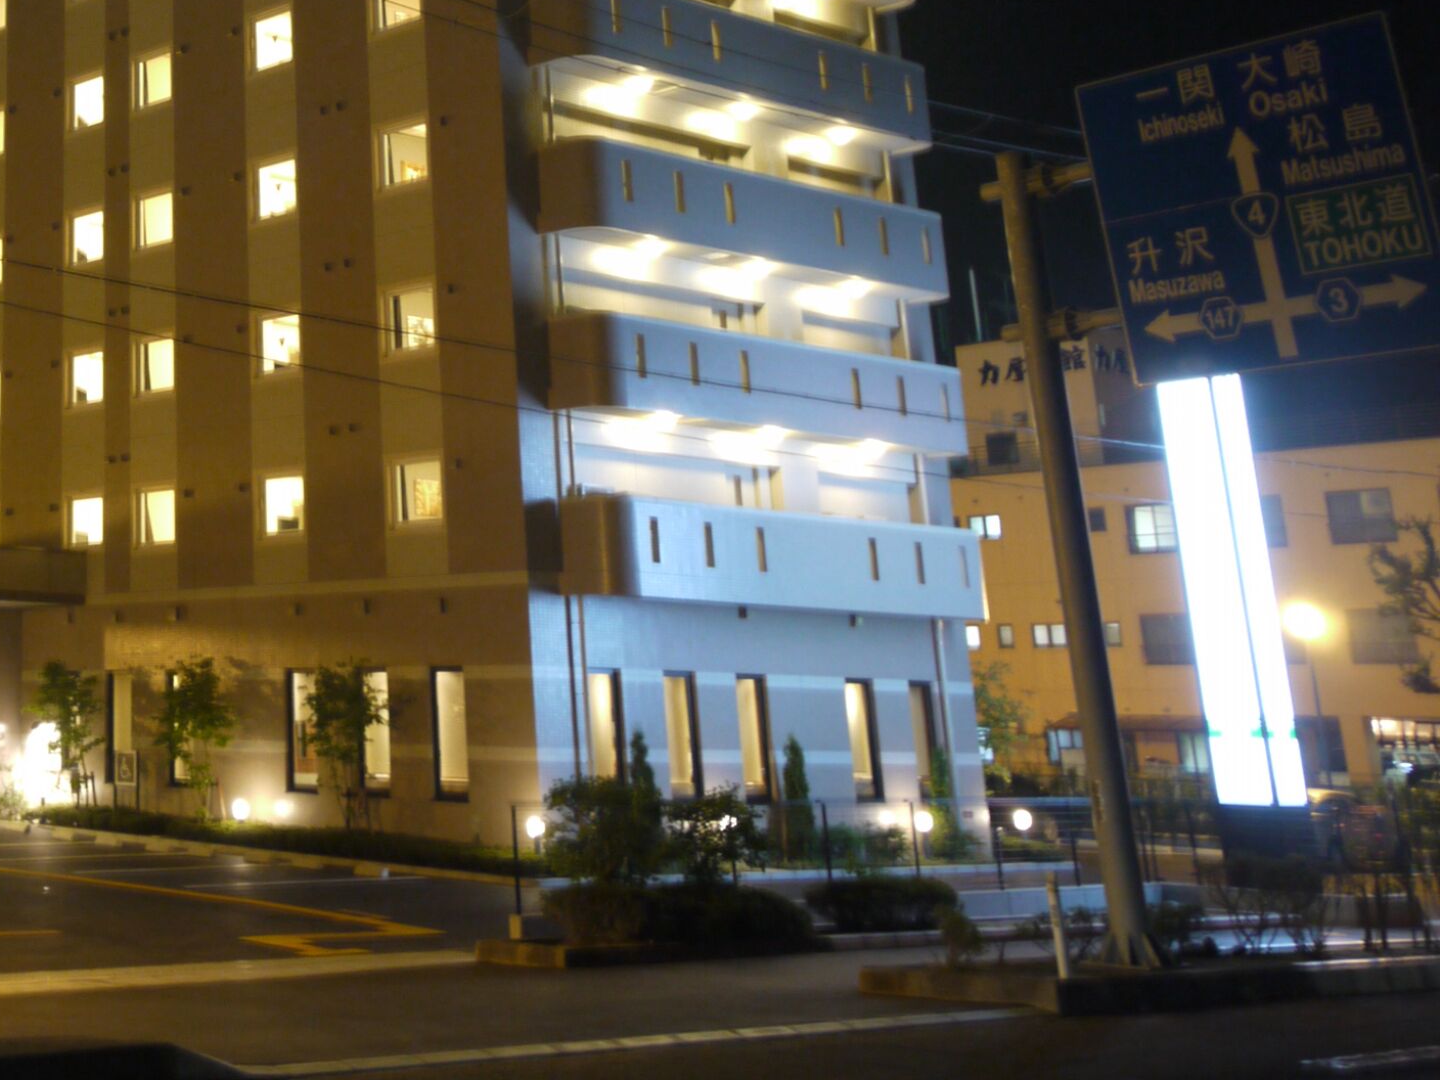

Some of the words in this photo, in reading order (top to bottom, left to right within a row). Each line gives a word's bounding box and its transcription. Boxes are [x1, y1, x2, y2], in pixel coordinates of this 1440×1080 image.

[1135, 63, 1215, 105] 一関
[1236, 39, 1323, 92] 大崎
[1248, 77, 1329, 118] Osaki
[1137, 101, 1226, 144] Ichinoseki
[1287, 102, 1384, 153] 松島
[1281, 143, 1406, 185] Matsushima
[1247, 200, 1266, 224] 4
[1295, 184, 1416, 236] 東北道
[1127, 226, 1215, 275] 升沢
[1304, 223, 1424, 268] TOHOKU
[1128, 270, 1226, 305] Masuzawa
[1328, 287, 1349, 312] 3
[1206, 305, 1235, 329] 147
